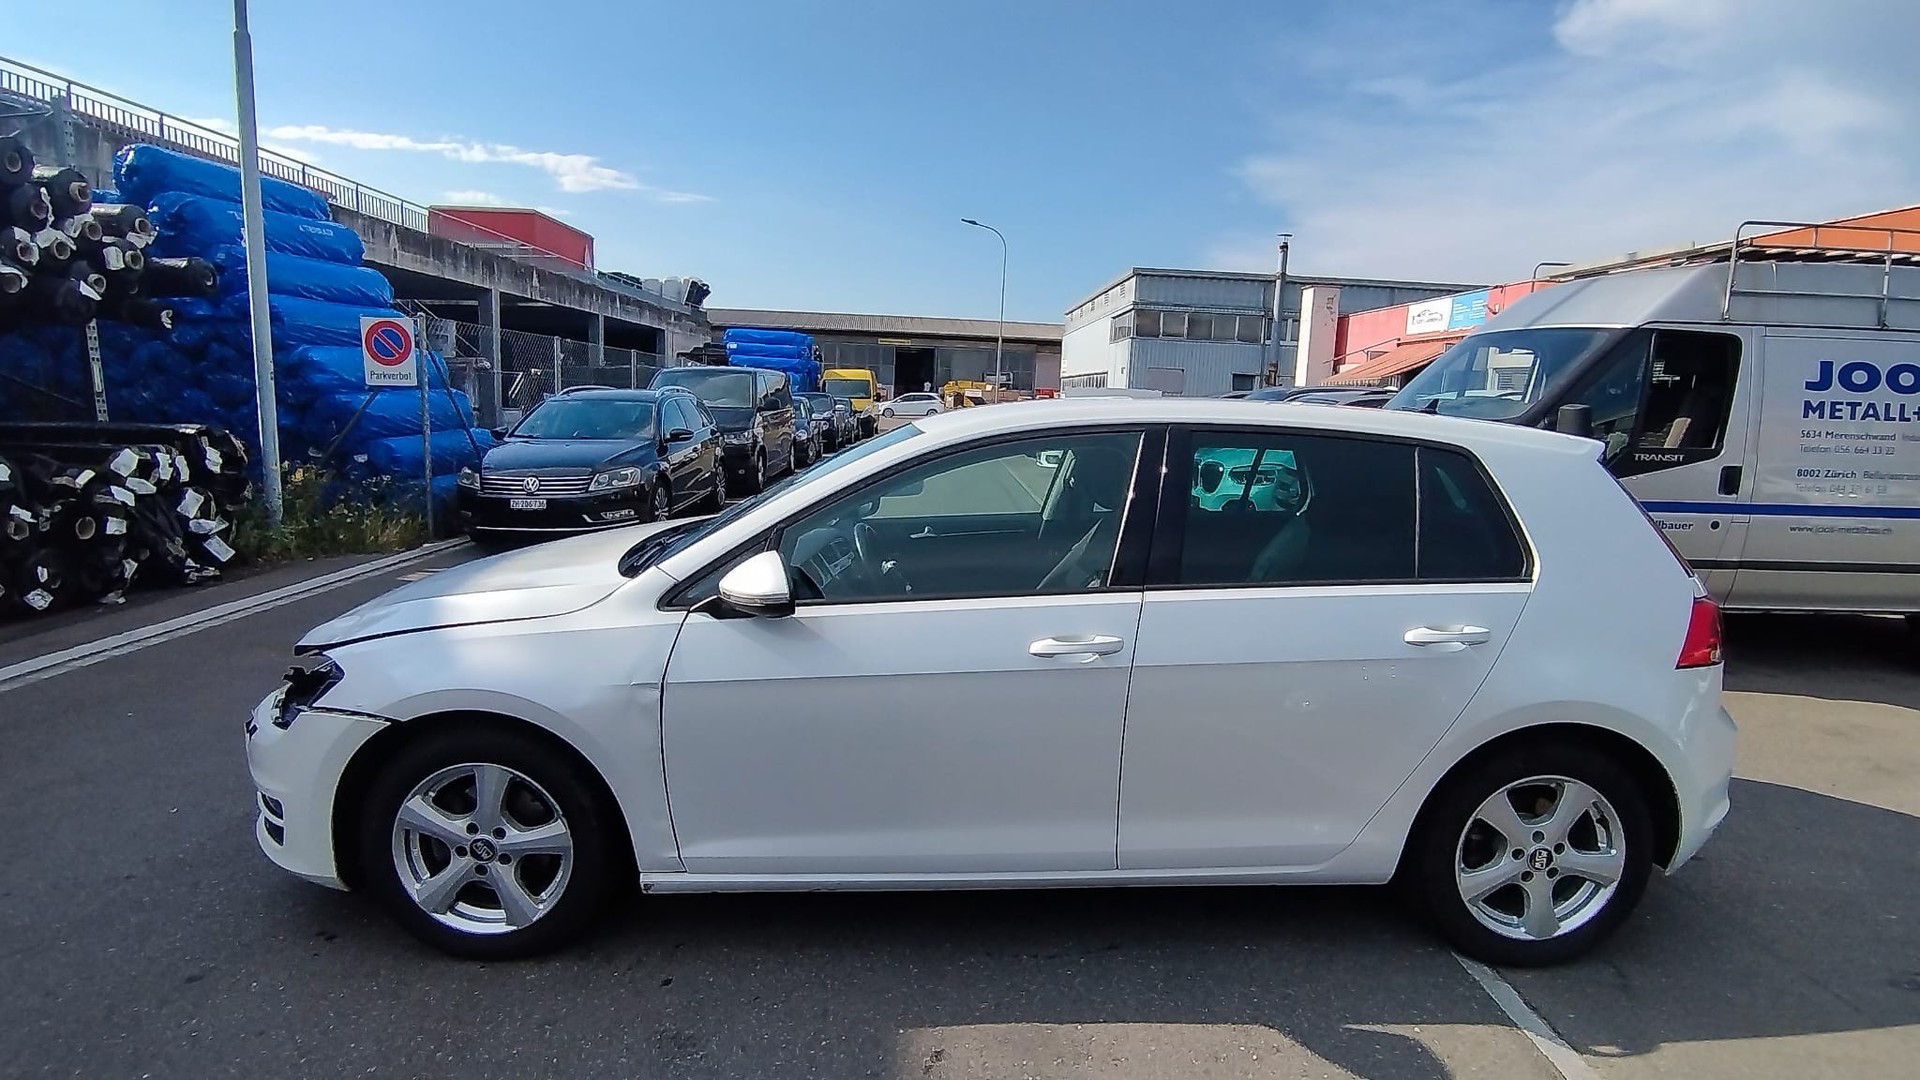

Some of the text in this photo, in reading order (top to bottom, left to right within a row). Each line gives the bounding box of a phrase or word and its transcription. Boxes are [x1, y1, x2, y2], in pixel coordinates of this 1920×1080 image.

[370, 370, 412, 380] Parkverbot
[1804, 360, 1920, 395] JOO
[1800, 429, 1822, 439] 5634
[1825, 430, 1897, 441] Merenschwand
[1800, 443, 1831, 453] Telefon
[1633, 453, 1685, 462] TRANSIT
[1796, 468, 1821, 478] 8002
[1824, 469, 1857, 479] Zürich
